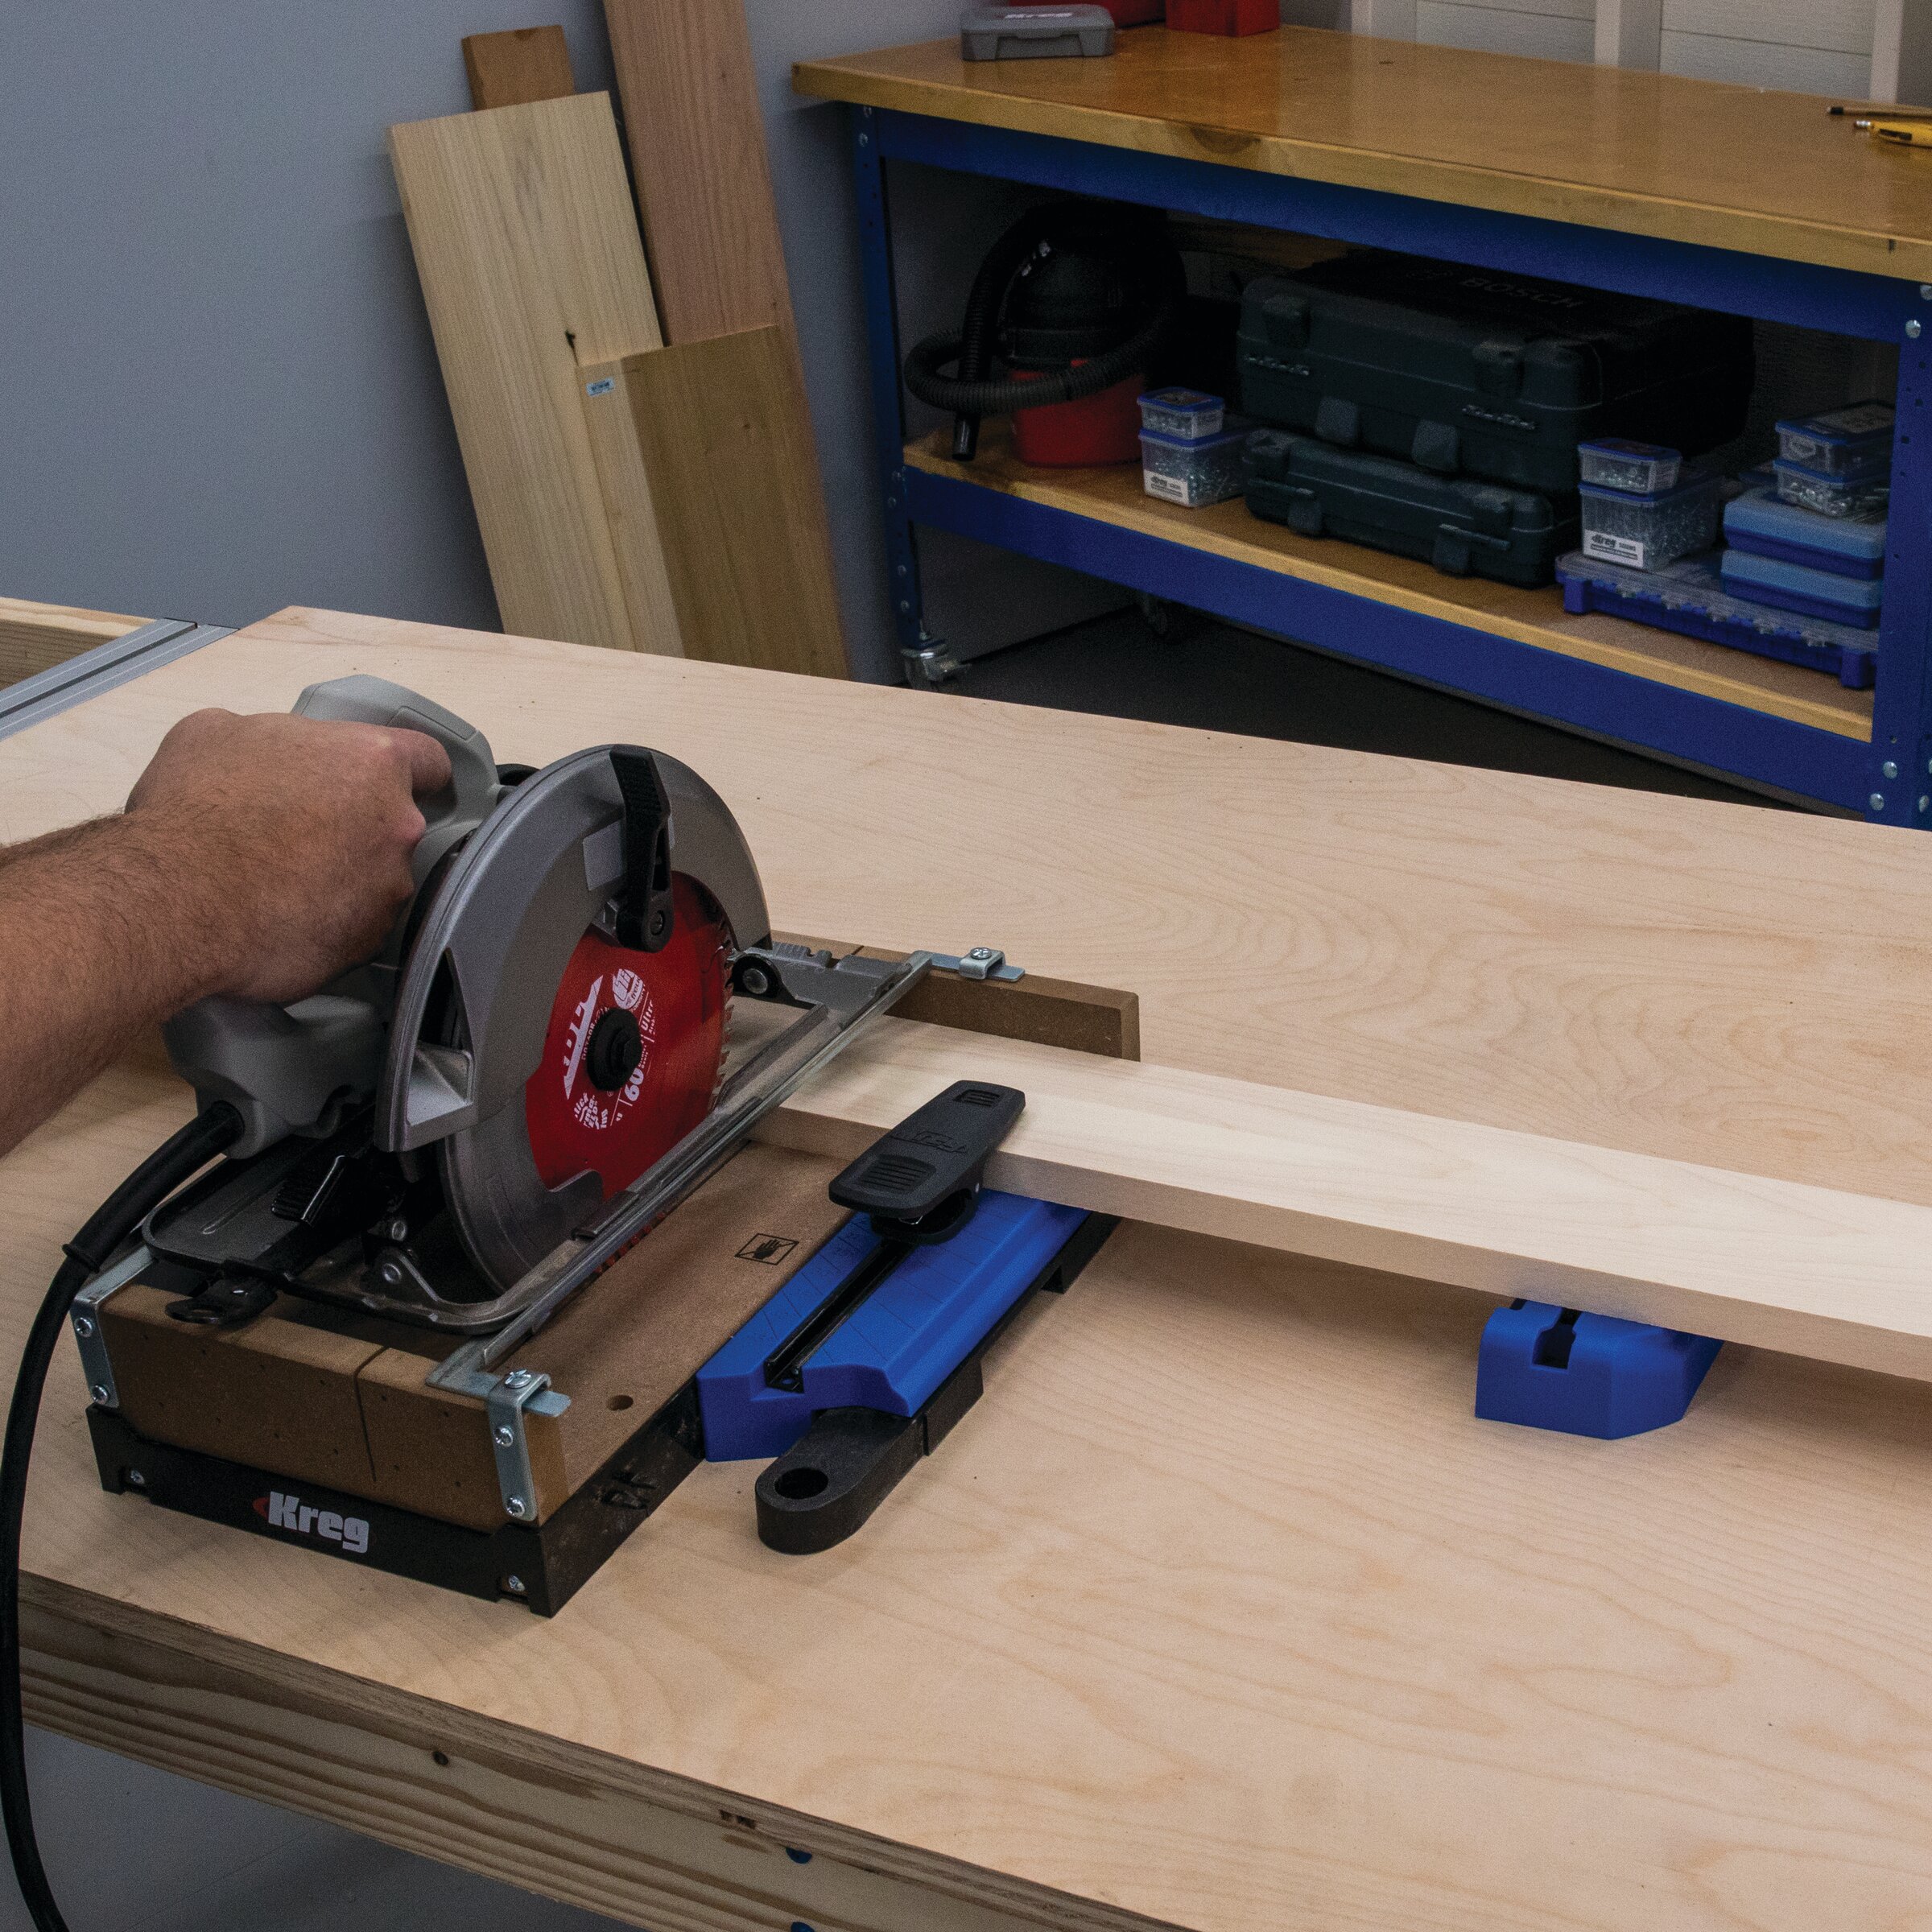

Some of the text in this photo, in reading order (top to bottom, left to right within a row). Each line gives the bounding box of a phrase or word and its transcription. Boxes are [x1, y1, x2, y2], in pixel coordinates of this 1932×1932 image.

[1459, 277, 1584, 308] BOSCH
[625, 1067, 645, 1102] 60
[268, 1491, 369, 1554] Kreg
